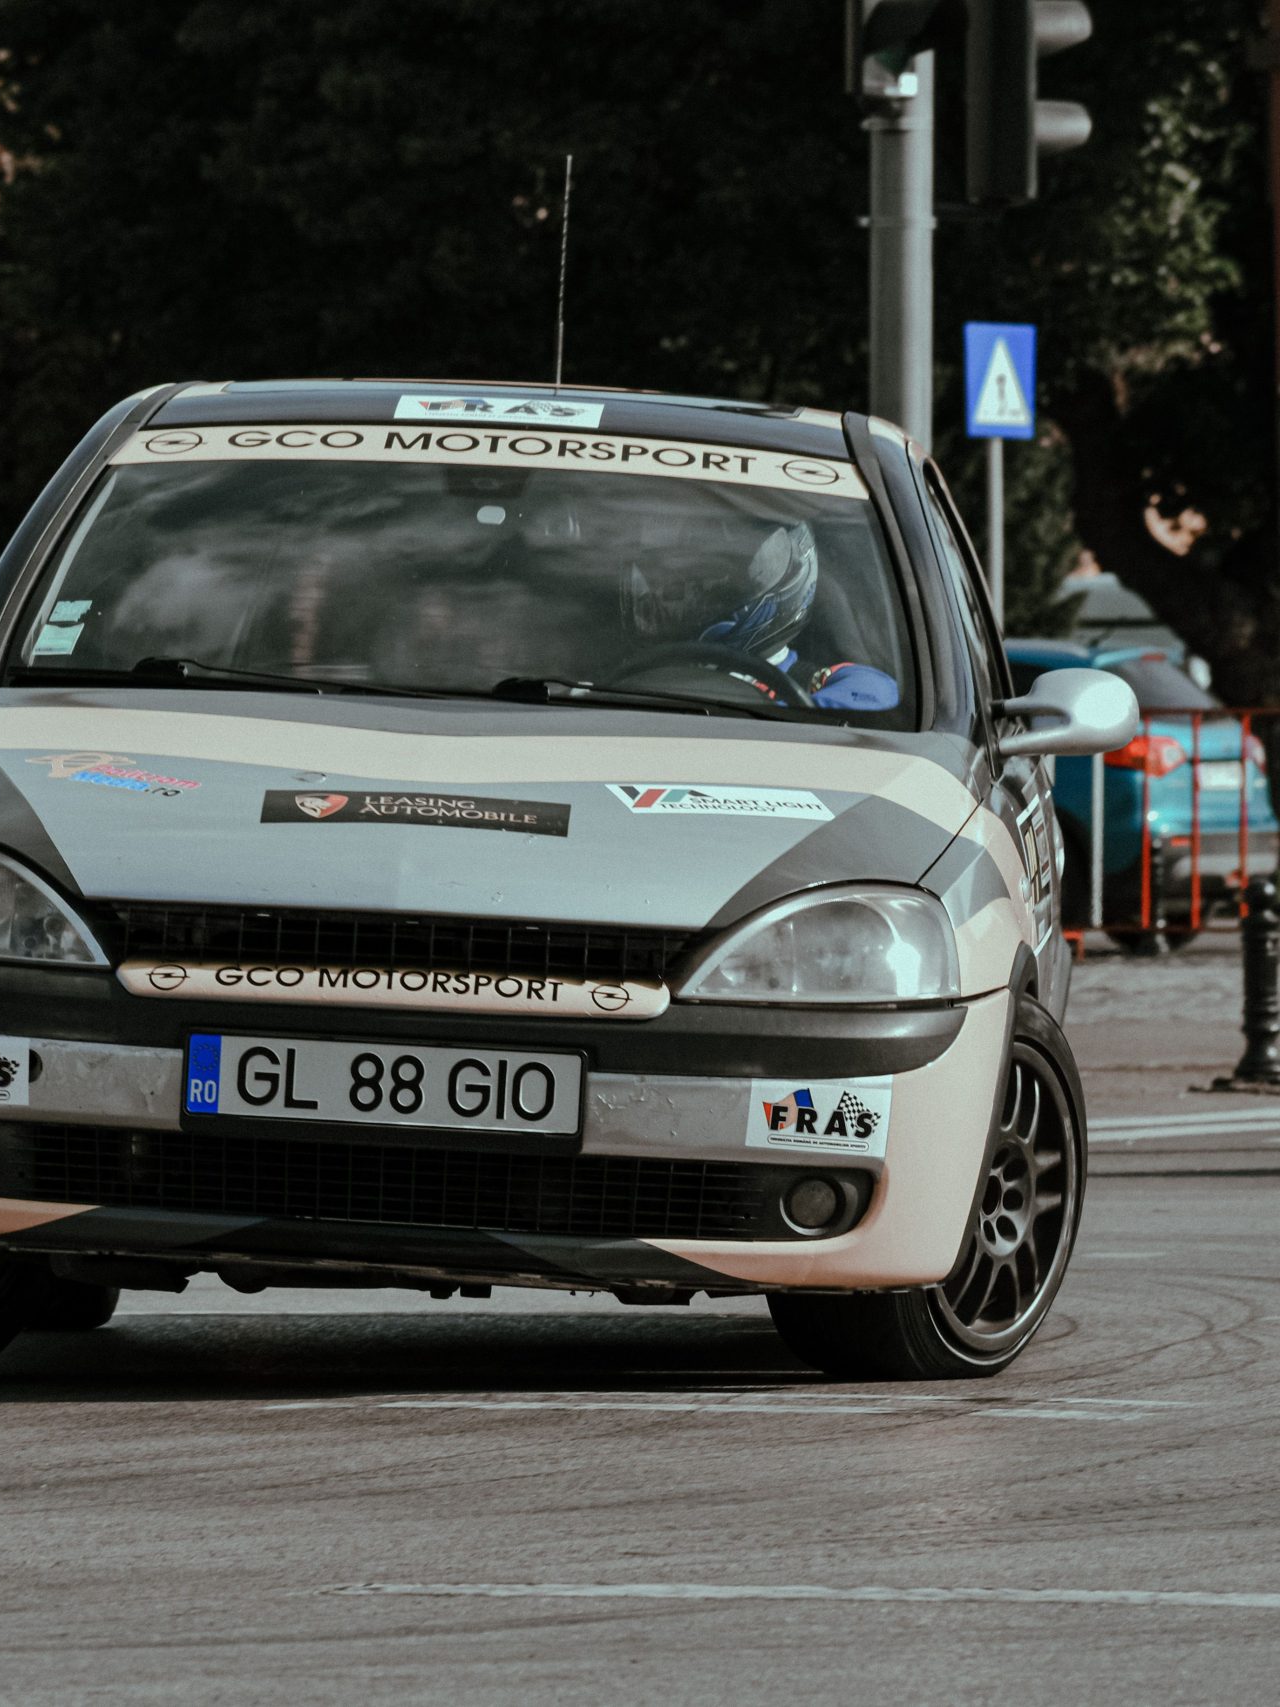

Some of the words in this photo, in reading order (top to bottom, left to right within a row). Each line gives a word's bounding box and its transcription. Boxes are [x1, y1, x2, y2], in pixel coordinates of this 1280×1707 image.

[227, 429, 364, 449] GCO
[384, 431, 757, 475] MOTORSPORT
[359, 803, 538, 825] AUTOMOBILE
[365, 795, 475, 809] LEASING
[660, 803, 776, 812] TECHNOLOGY
[689, 797, 758, 806] SMART
[764, 800, 823, 811] LIGHT
[215, 966, 305, 988] GCO
[318, 968, 564, 1002] MOTORSPORT
[190, 1078, 217, 1104] RO
[237, 1045, 318, 1110] GL
[349, 1051, 425, 1115] 88
[447, 1057, 556, 1122] GIO
[770, 1105, 874, 1139] FRAS
